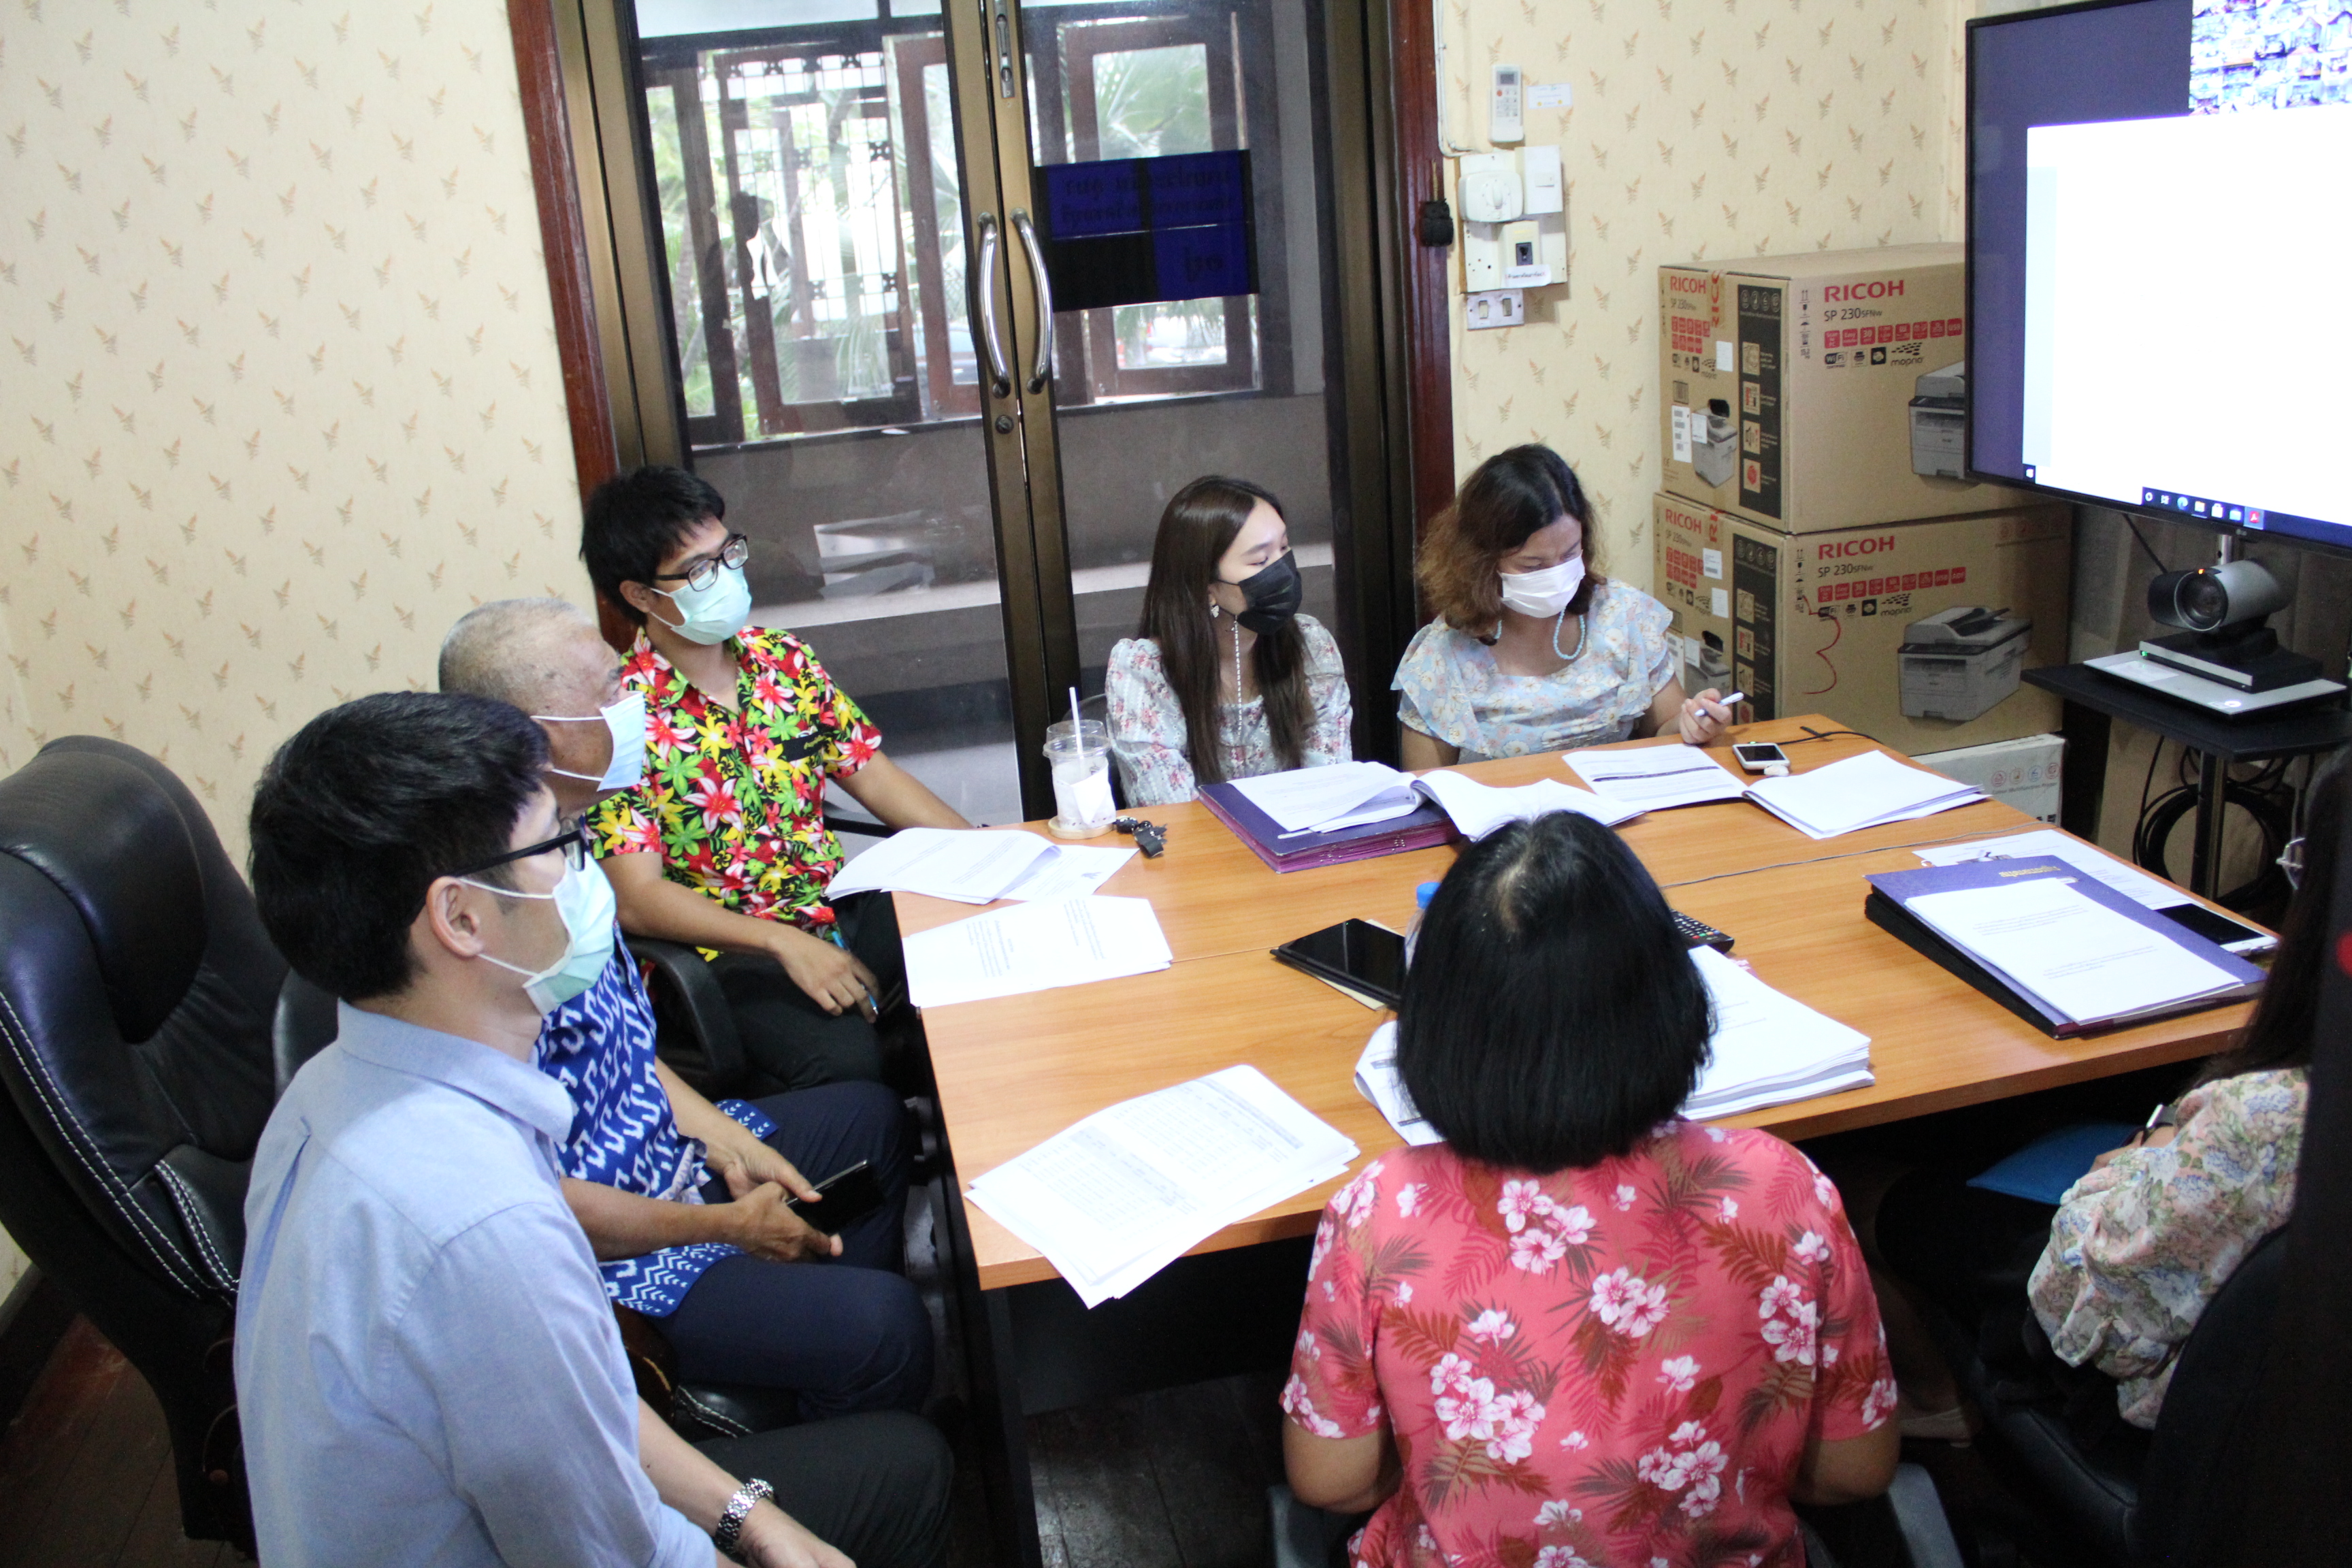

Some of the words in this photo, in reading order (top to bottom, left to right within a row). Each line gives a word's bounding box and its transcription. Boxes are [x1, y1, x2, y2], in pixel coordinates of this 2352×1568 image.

[1670, 275, 1707, 294] RICOH
[1825, 279, 1905, 303] RICOH
[1824, 310, 1838, 322] SP
[1863, 329, 1873, 338] 30
[1665, 508, 1701, 534] RICOH
[1818, 535, 1895, 560] RICOH
[1818, 566, 1831, 578] SP
